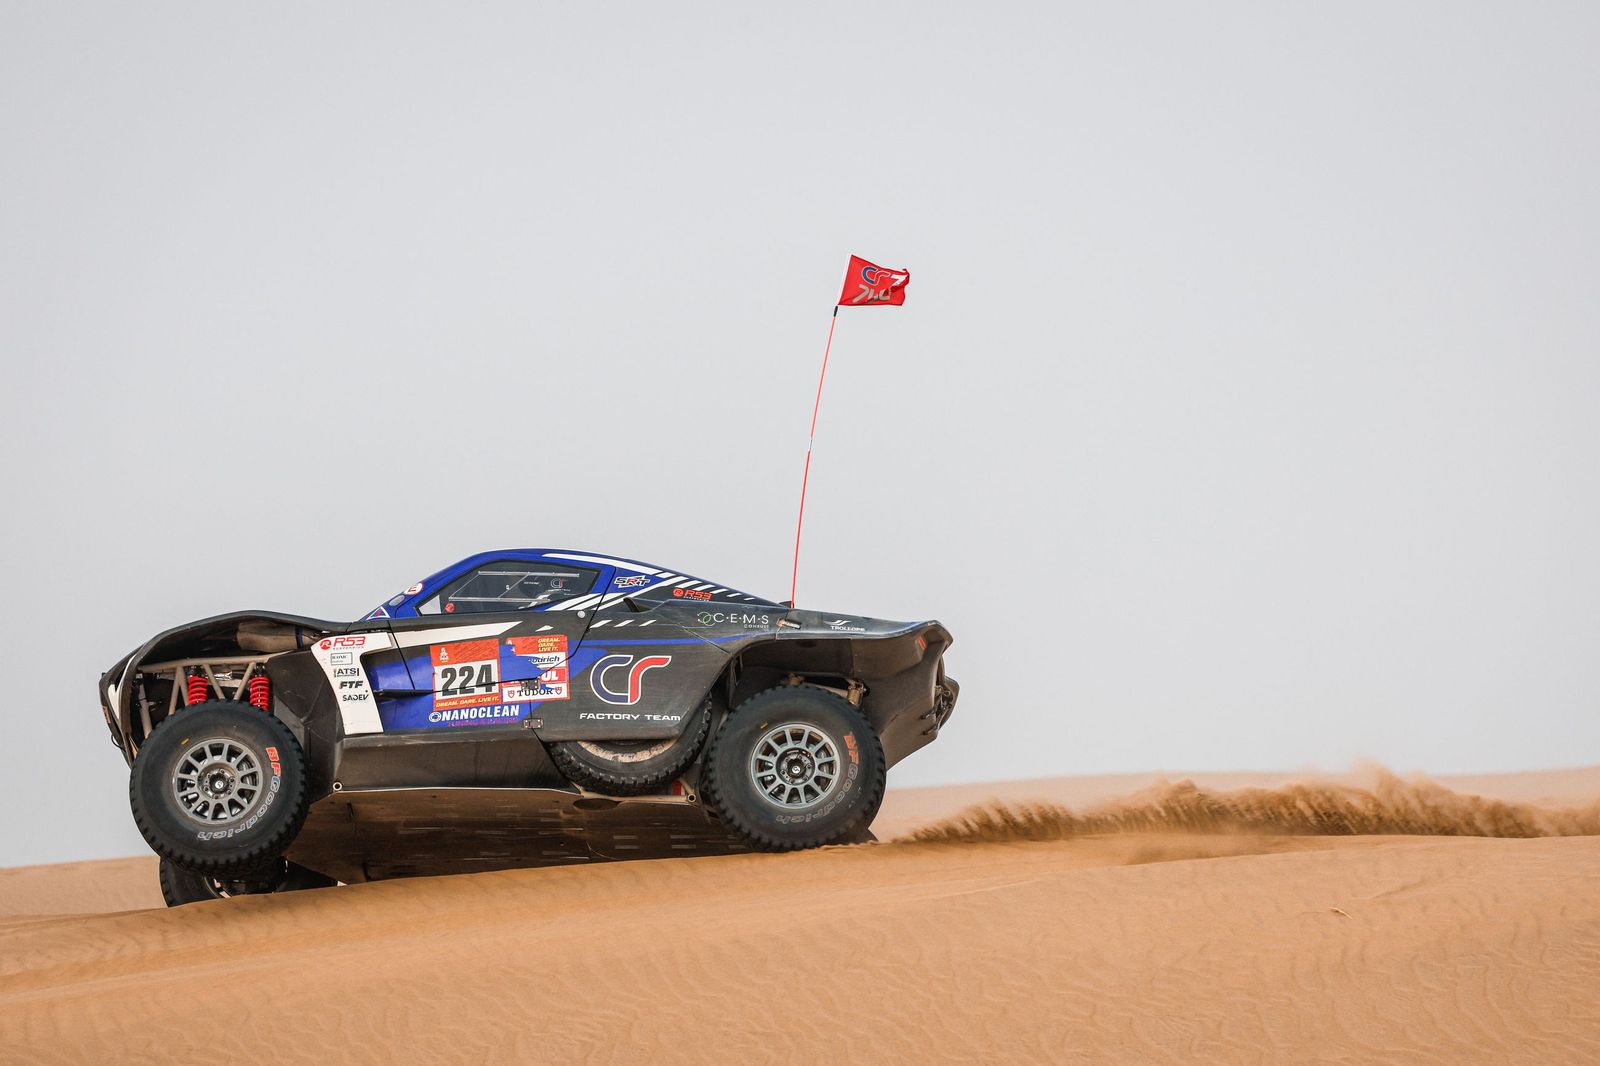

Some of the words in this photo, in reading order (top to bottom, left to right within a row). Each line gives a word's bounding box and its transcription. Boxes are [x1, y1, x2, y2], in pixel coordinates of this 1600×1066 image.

[684, 589, 712, 600] RS3
[333, 636, 366, 647] RS3
[339, 681, 363, 689] FTF
[441, 664, 496, 697] 224
[517, 689, 553, 697] TUDOR
[441, 705, 519, 721] NANOCLEAN
